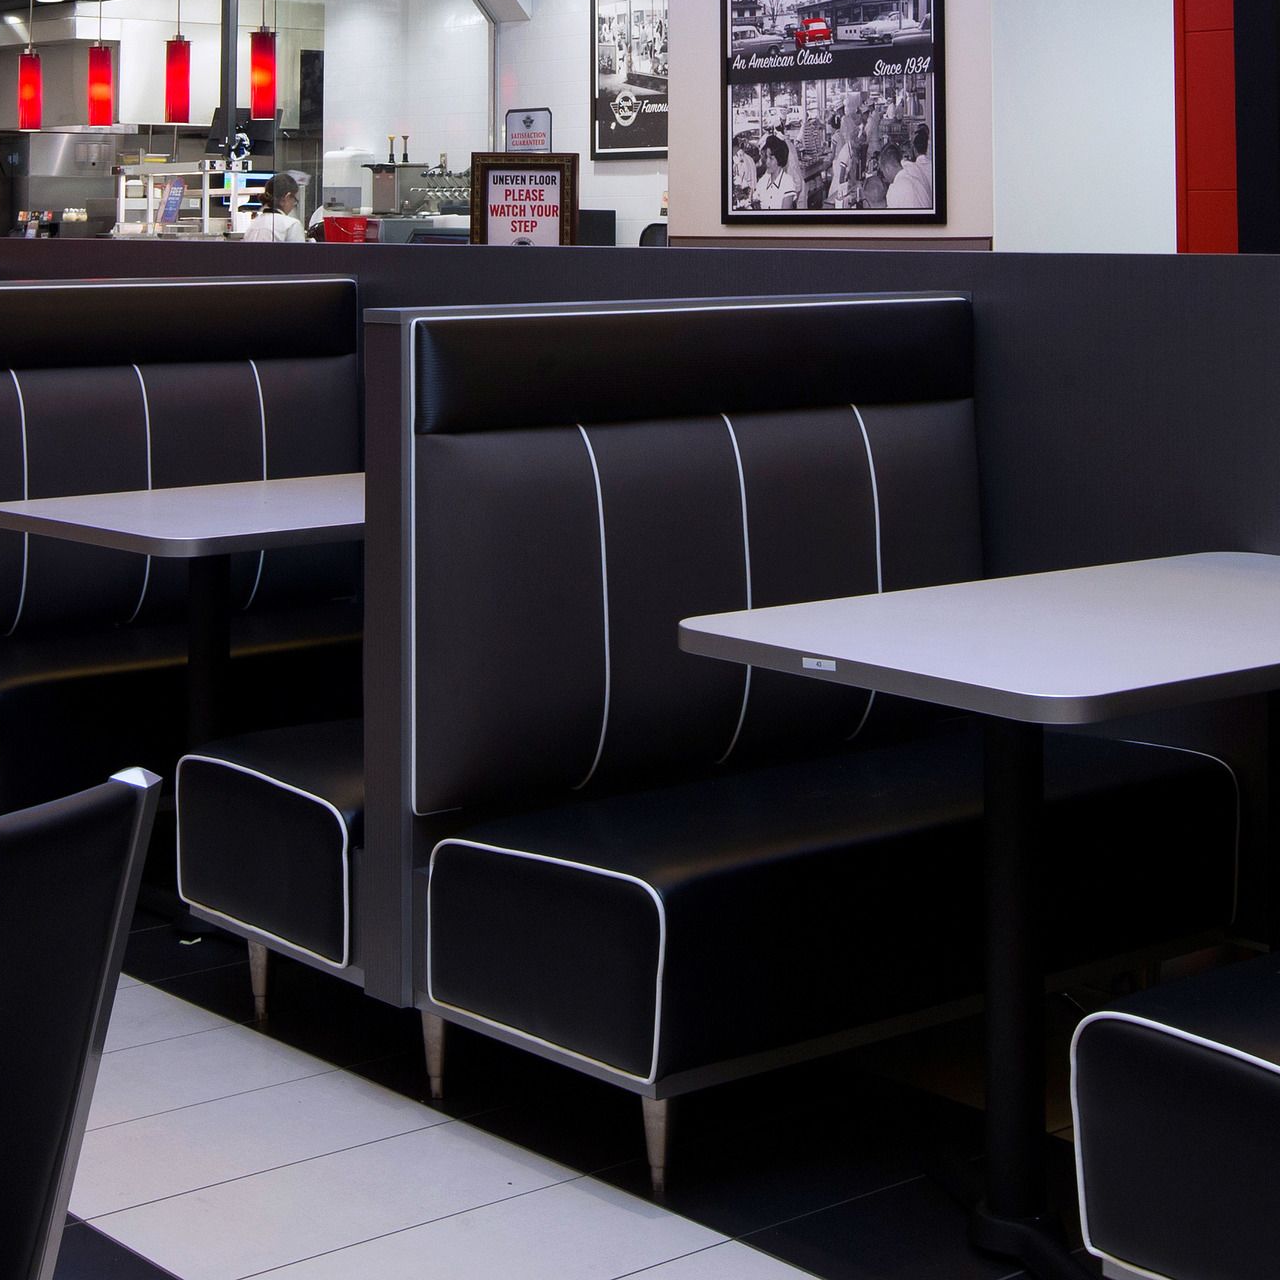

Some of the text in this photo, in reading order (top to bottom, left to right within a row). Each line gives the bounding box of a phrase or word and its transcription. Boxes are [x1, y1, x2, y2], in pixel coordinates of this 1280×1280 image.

[732, 49, 833, 70] An American Classic
[873, 56, 931, 77] Since 1934
[511, 139, 545, 147] GUARANTEED
[492, 175, 557, 186] UNEVEN FLOOR
[504, 189, 545, 202] PLEASE
[489, 204, 559, 218] WATCH YOUR
[510, 220, 538, 233] STEP
